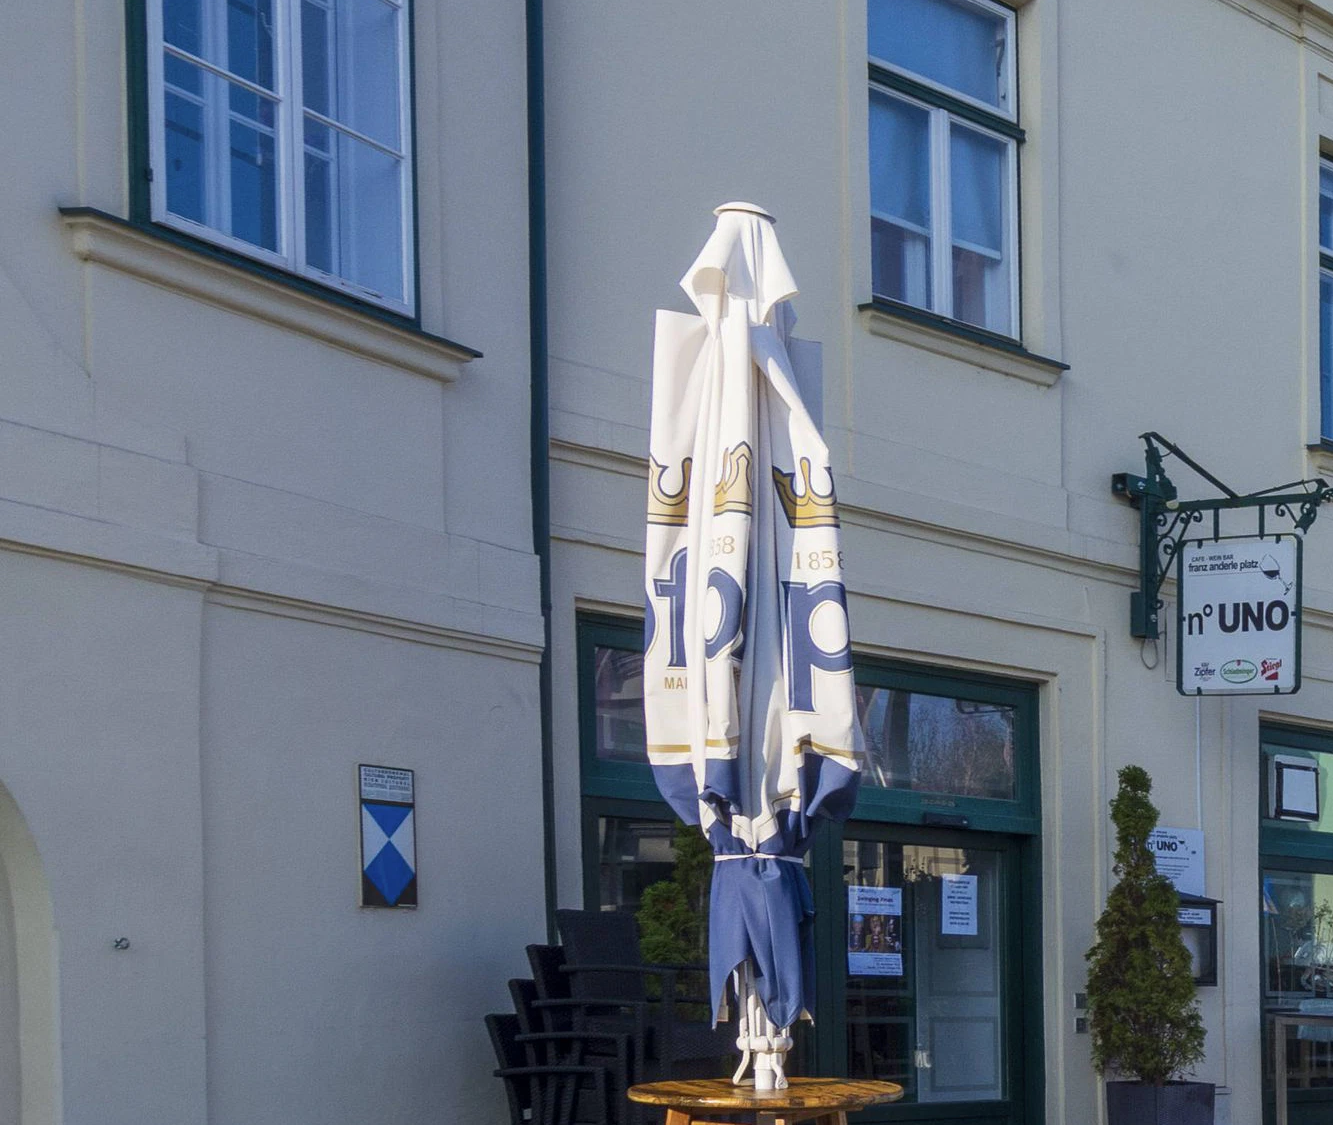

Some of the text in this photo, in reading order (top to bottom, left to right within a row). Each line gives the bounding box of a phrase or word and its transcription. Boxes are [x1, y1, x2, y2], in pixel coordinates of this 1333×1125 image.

[795, 550, 845, 570] 1858
[1188, 559, 1259, 573] franz anderle platz
[1218, 599, 1289, 633] UNO
[1194, 667, 1216, 677] Zipfer
[1156, 840, 1178, 852] UNO
